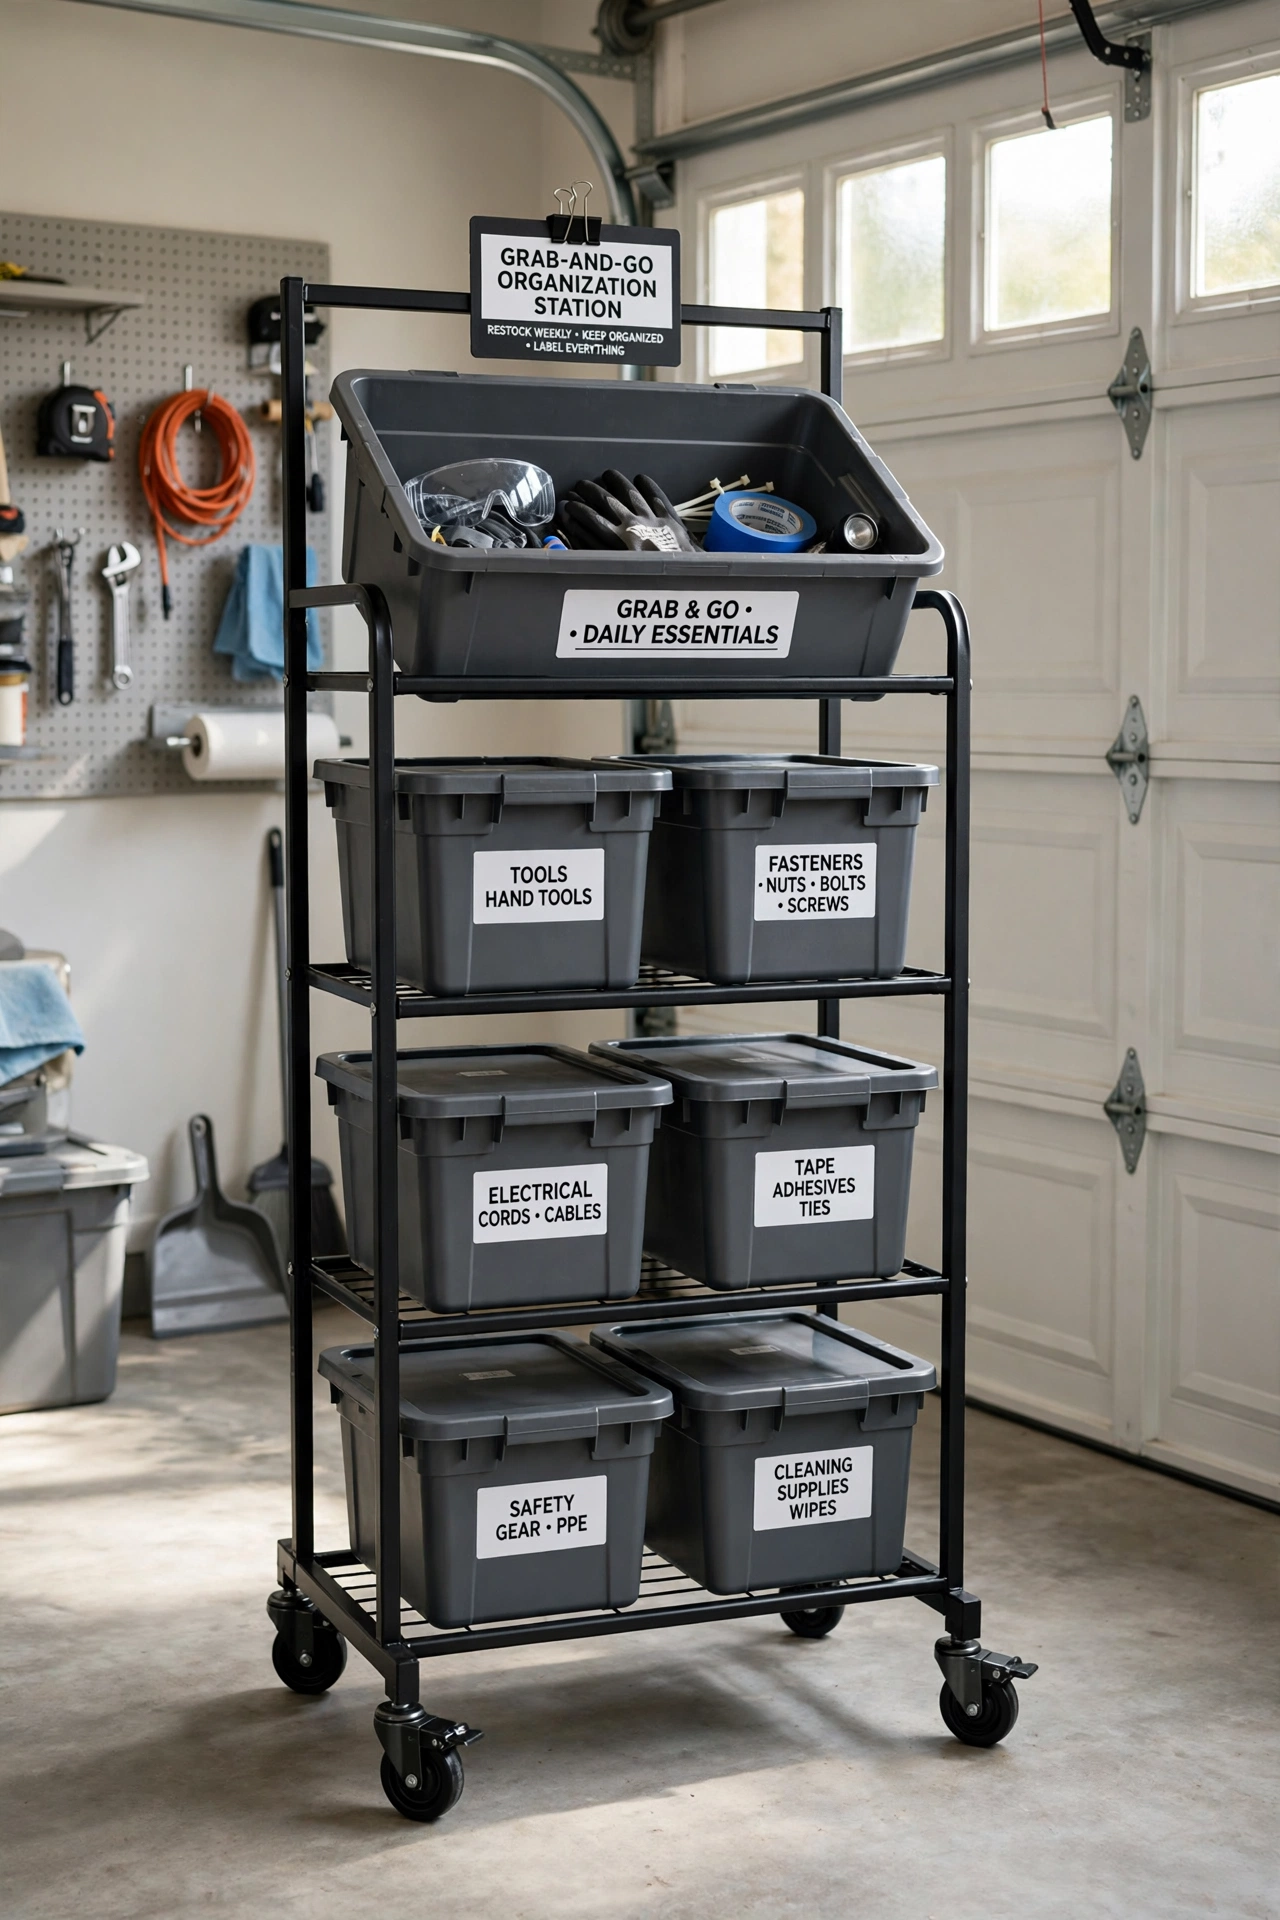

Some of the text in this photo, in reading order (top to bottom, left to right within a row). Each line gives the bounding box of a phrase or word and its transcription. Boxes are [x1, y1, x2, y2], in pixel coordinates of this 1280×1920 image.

[501, 247, 654, 274] GRAB-AND-GO
[498, 270, 657, 298] ORGANIZATION
[534, 296, 622, 319] STATION
[487, 325, 532, 337] RESTOCK
[534, 327, 572, 339] WEEKLY
[609, 331, 664, 344] ORGANIZED
[534, 341, 625, 356] LABEL EVERYTHING
[617, 599, 739, 619] GRAB & GO
[583, 624, 779, 644] DAILY ESSENTIALS
[769, 854, 863, 872] FASTENERS
[510, 866, 568, 884] TOOLS
[766, 875, 866, 893] NUTS BOLTS
[486, 888, 592, 908] HAND TOOLS
[788, 896, 849, 913] SCREWS
[795, 1158, 835, 1176] TAPE
[489, 1180, 592, 1204] ELECTRICAL
[772, 1178, 856, 1198] ADHESIVES
[478, 1203, 601, 1227] CORDS CABLES
[799, 1200, 830, 1217] TIES
[774, 1456, 853, 1480] CLEANING
[778, 1478, 849, 1501] SUPPLIES
[510, 1494, 574, 1518] SAFETY
[790, 1499, 837, 1520] WIPES
[496, 1514, 588, 1541] GEAR PPE
